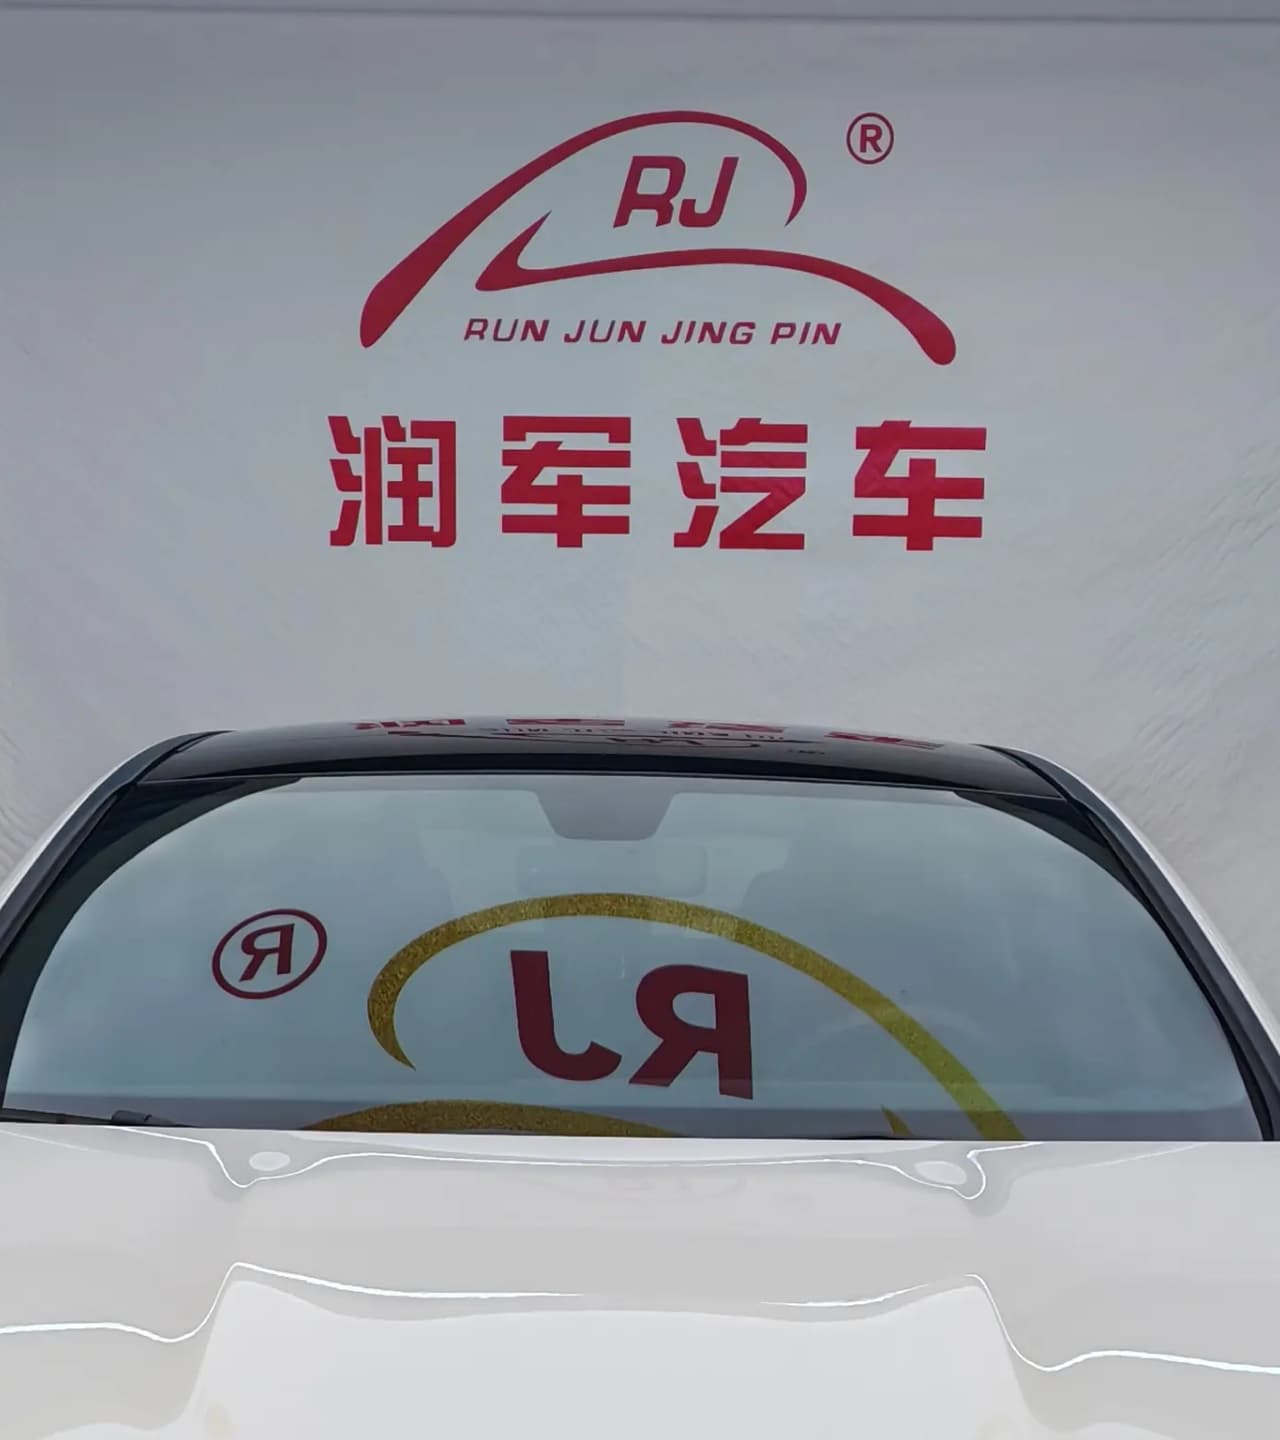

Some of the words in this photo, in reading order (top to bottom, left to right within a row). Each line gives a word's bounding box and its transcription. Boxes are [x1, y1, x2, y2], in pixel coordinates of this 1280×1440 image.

[613, 155, 739, 228] RJ
[463, 318, 550, 342] RUN
[562, 320, 646, 344] JUN
[660, 320, 756, 346] JING
[769, 321, 842, 346] PIN
[327, 415, 988, 552] 润军汽车
